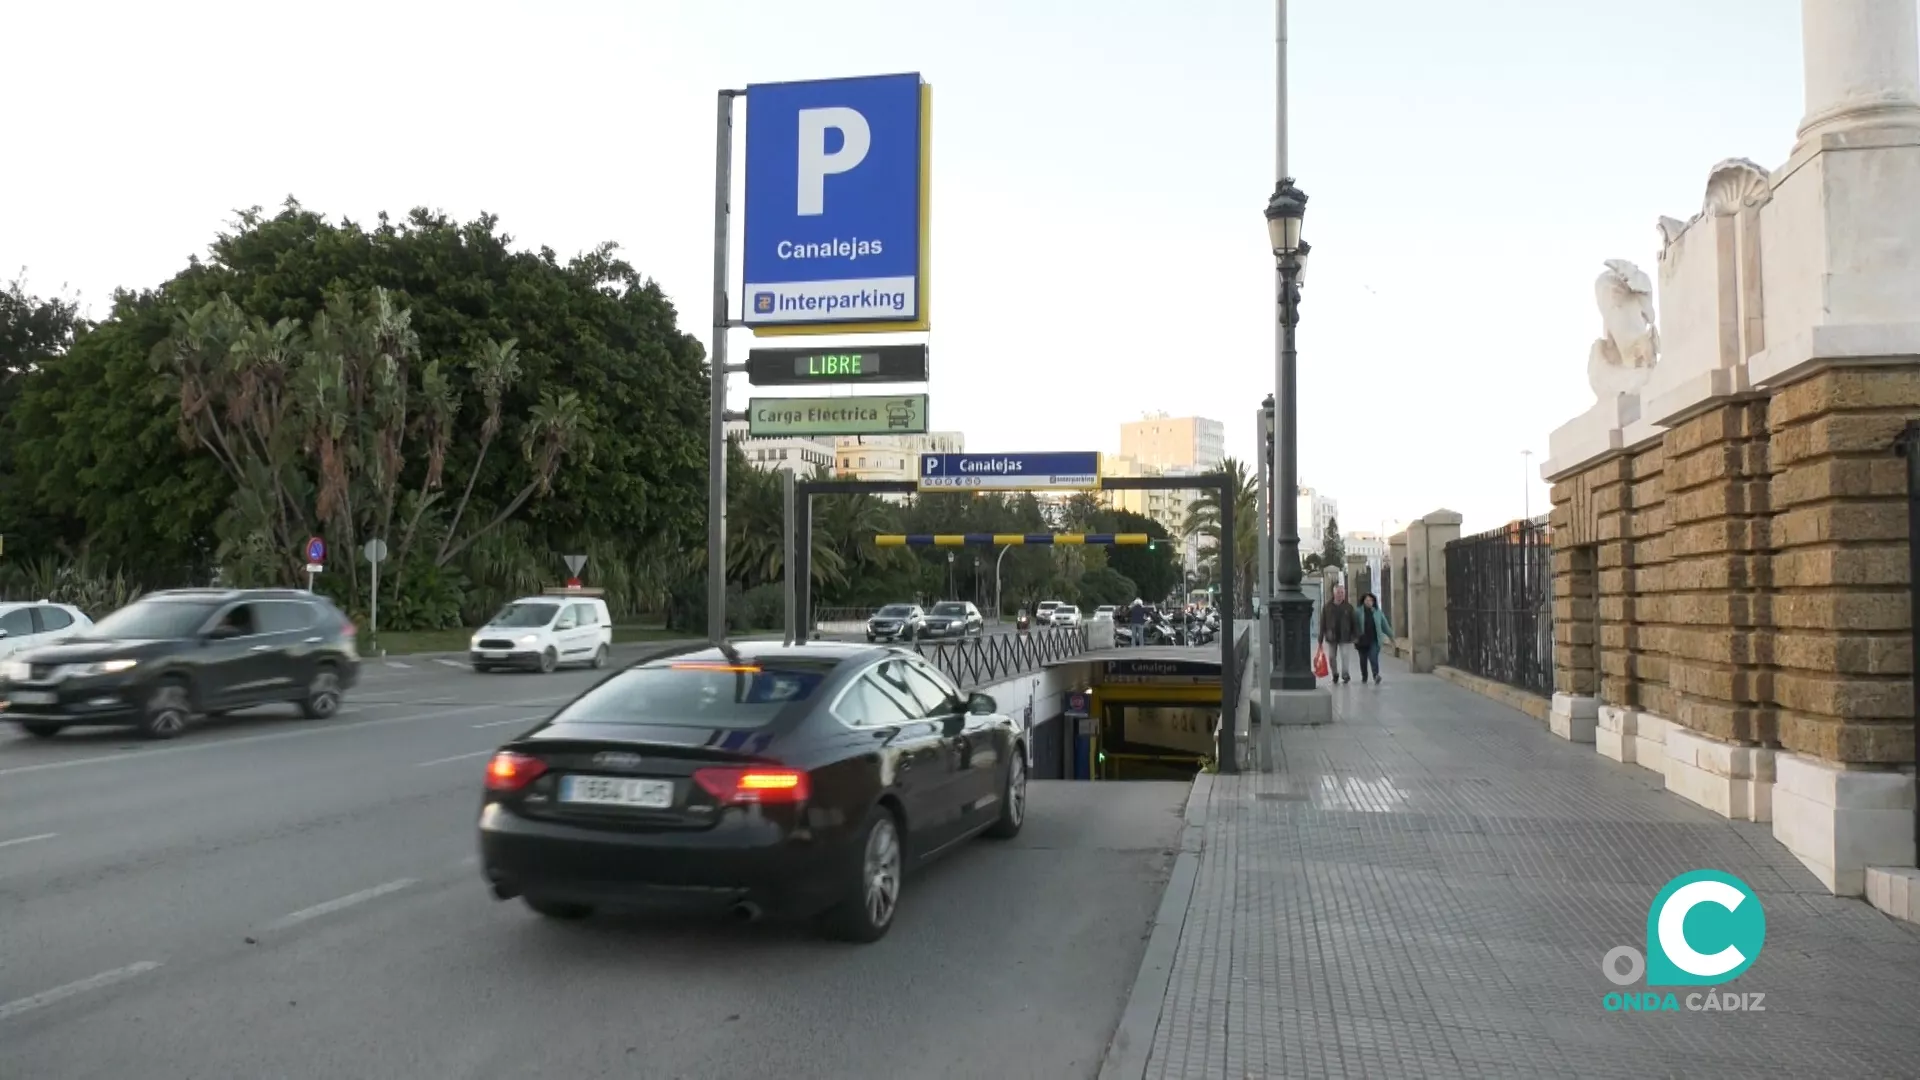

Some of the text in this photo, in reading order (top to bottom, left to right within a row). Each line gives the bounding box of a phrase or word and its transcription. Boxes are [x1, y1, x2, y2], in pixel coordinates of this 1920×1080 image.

[798, 107, 871, 216] P
[777, 237, 882, 260] Canalejas
[779, 289, 905, 313] Interparking
[809, 355, 862, 375] LIBRE
[758, 408, 803, 425] Carga
[927, 457, 1023, 474] P Canalejas
[1131, 663, 1178, 674] Canalejas
